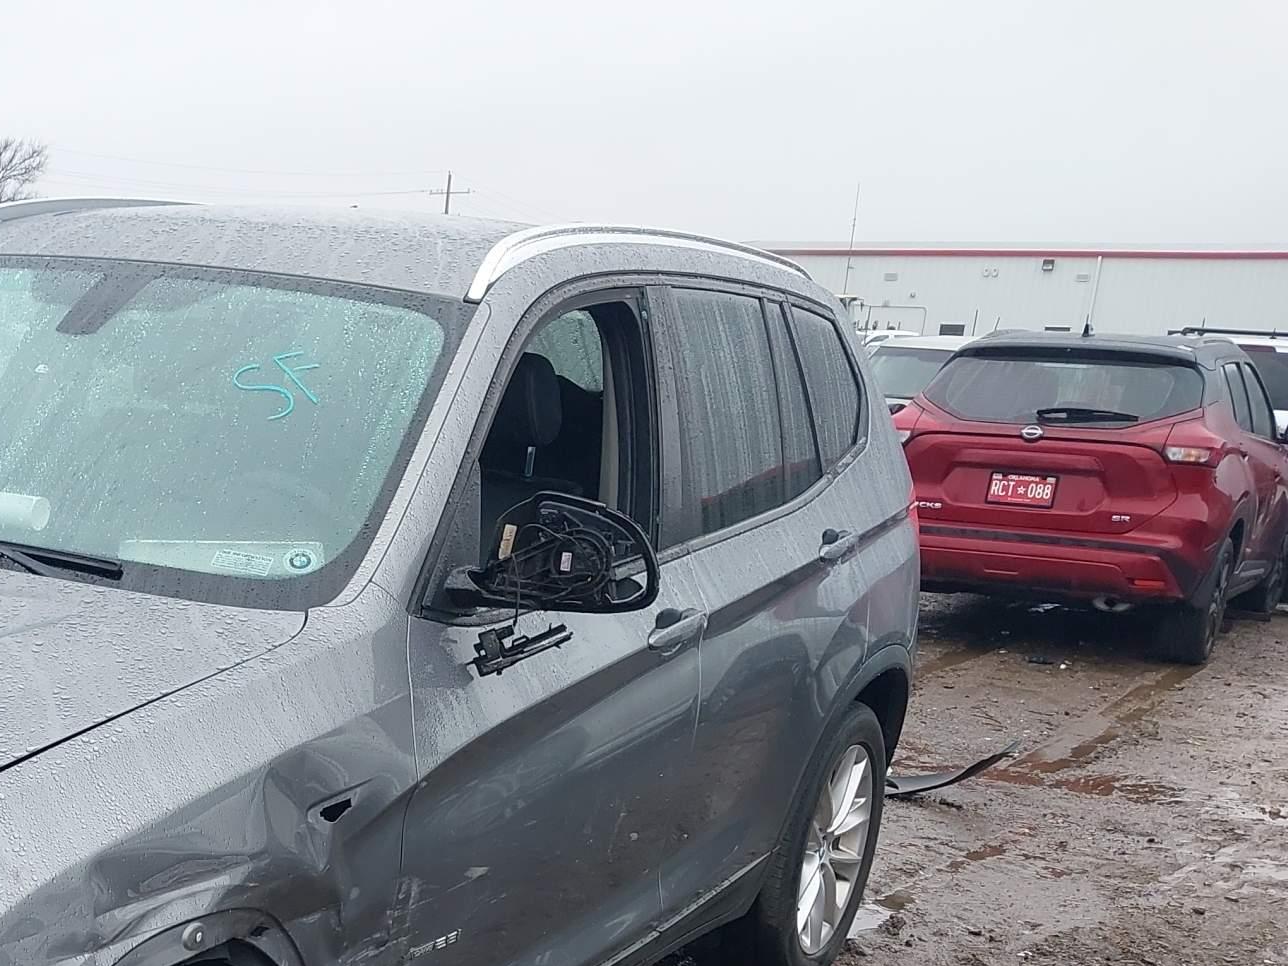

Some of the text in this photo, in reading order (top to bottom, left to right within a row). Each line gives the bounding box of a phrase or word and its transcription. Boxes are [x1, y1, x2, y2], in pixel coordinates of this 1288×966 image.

[233, 351, 321, 421] SF
[990, 479, 1053, 499] RCT 088
